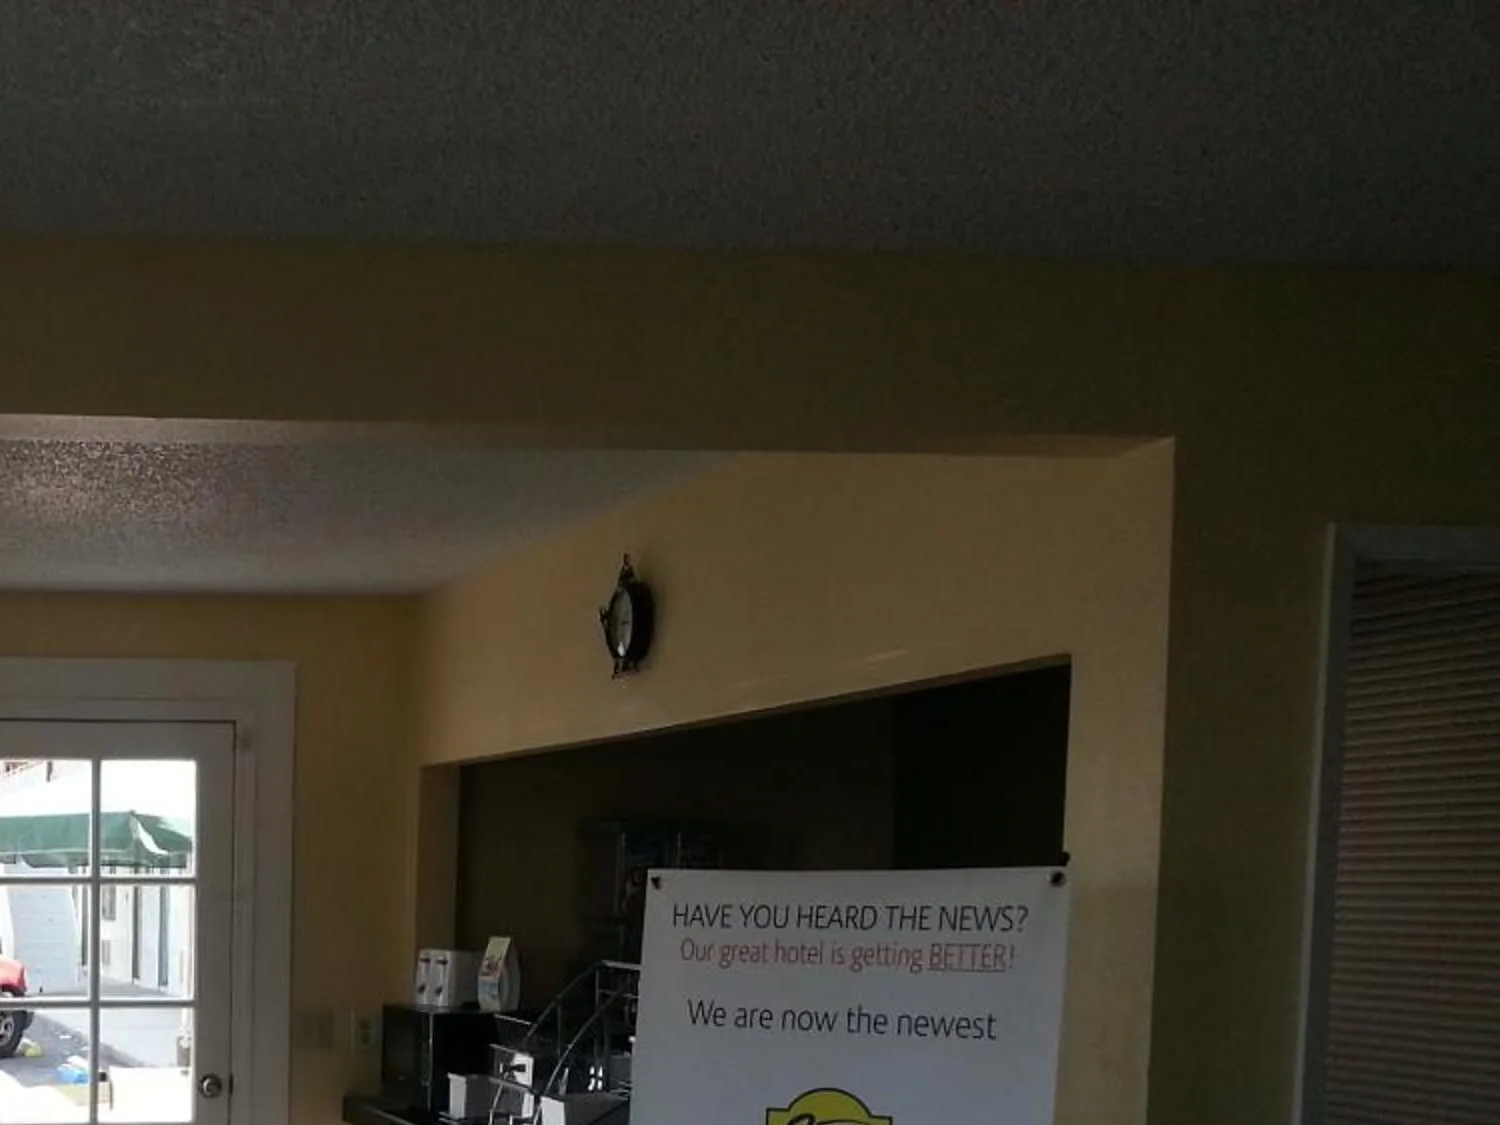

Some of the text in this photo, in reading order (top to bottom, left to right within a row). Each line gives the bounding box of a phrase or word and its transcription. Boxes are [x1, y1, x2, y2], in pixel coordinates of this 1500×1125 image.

[673, 903, 1029, 931] HAVE YOU HEARD THE NEWS?
[680, 938, 1015, 972] Our great hotel is getting BETTER!
[687, 999, 997, 1040] We are now the newest
